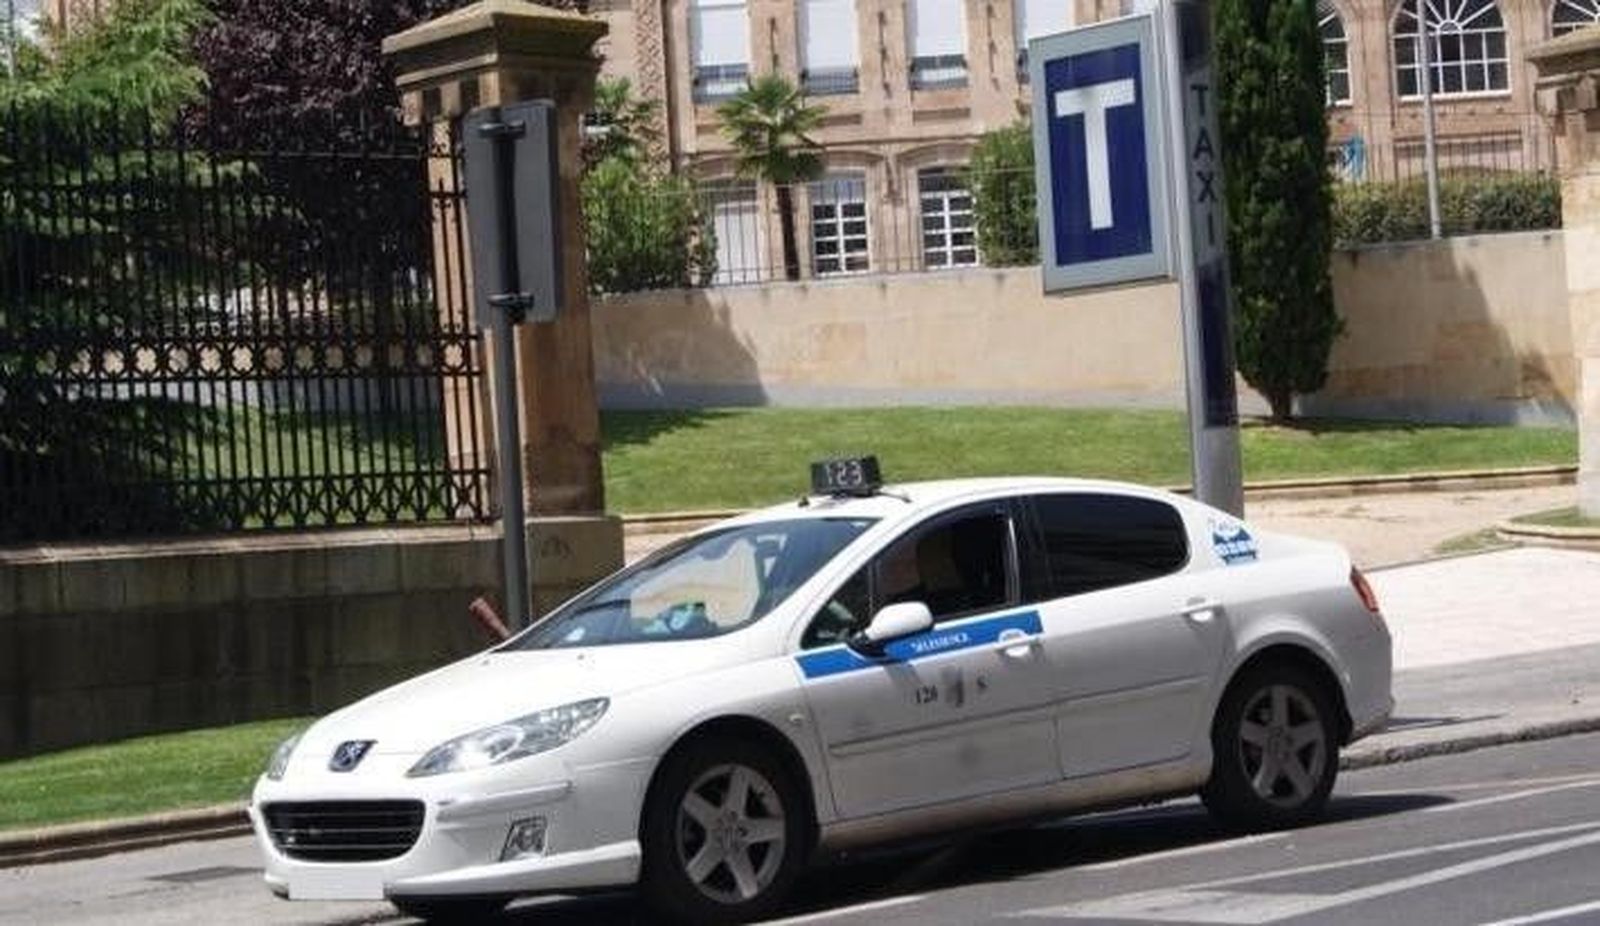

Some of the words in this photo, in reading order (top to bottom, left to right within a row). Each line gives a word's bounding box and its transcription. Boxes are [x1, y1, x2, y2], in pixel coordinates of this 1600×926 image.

[1054, 78, 1136, 230] T
[1190, 84, 1216, 245] TAXI
[825, 460, 862, 486] 123
